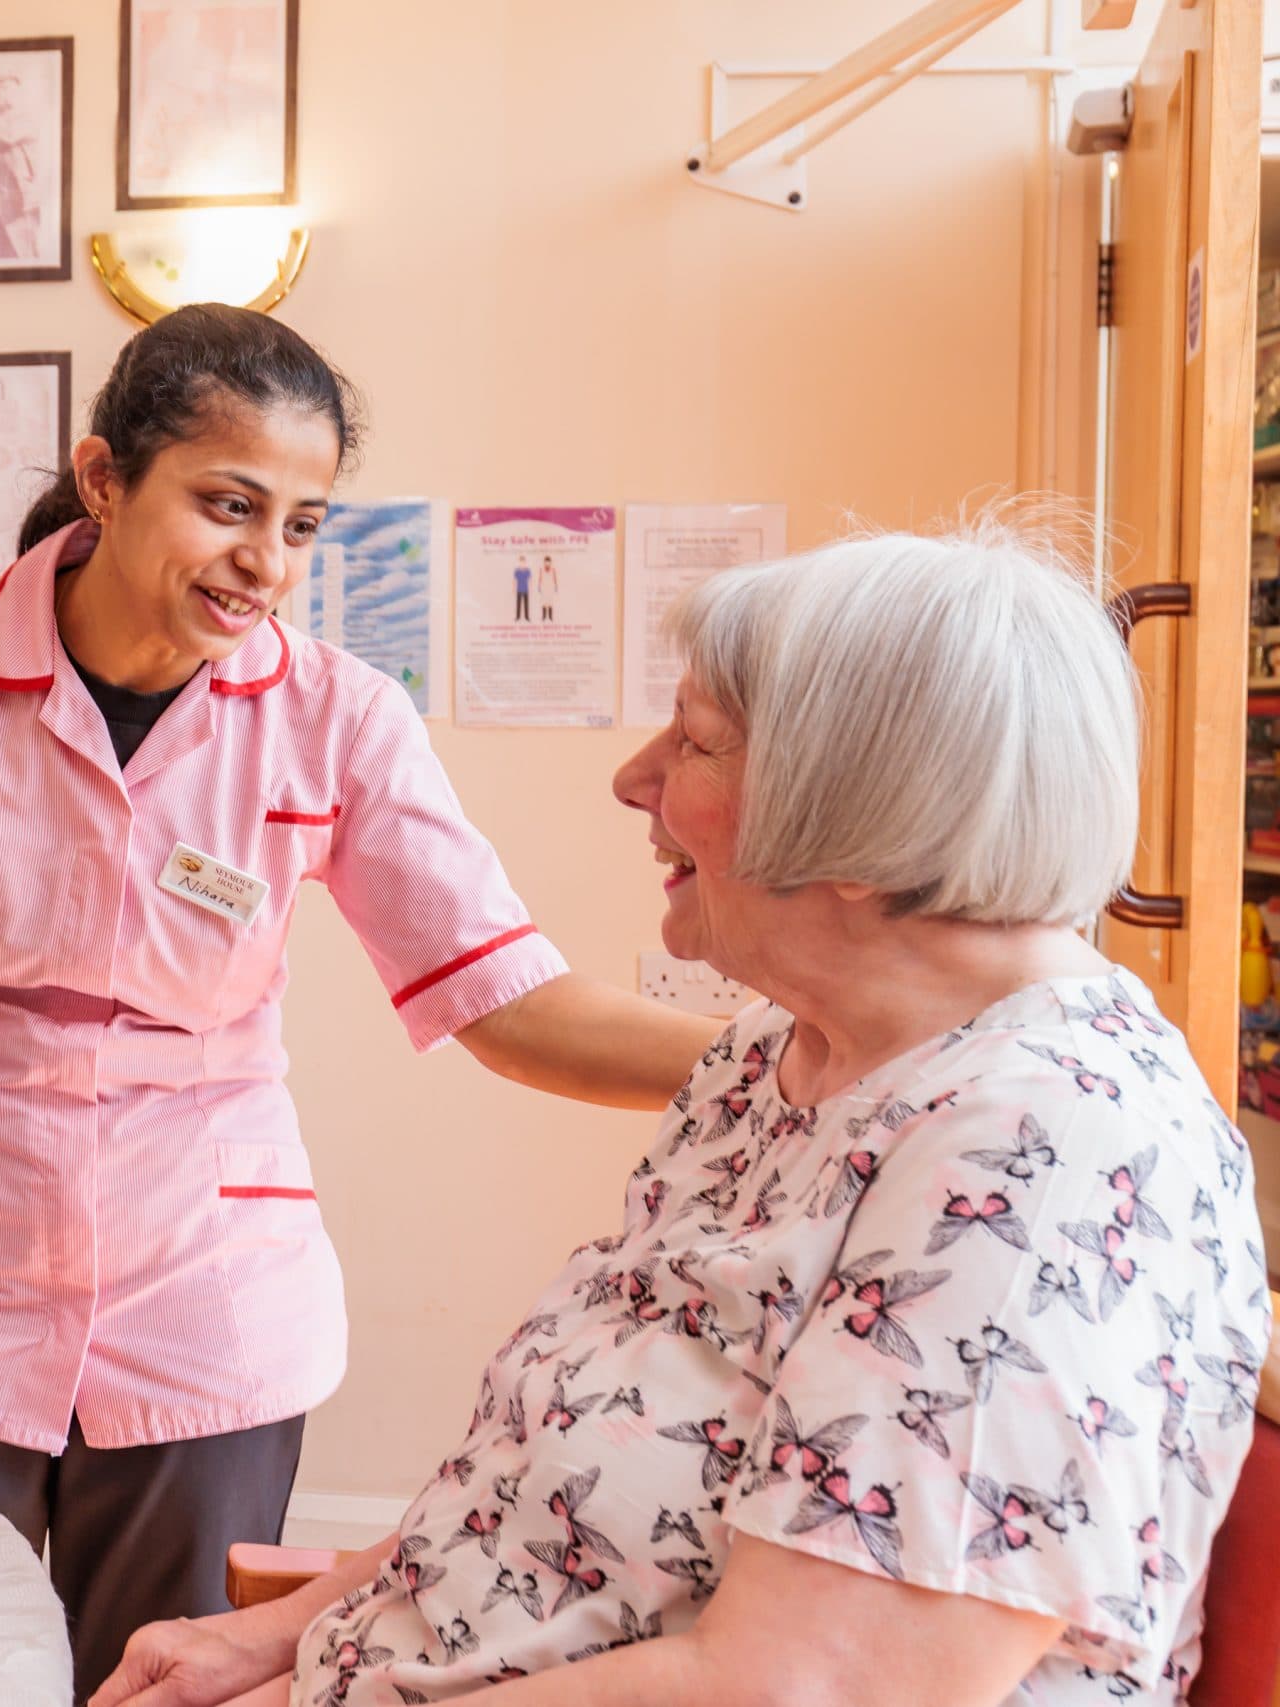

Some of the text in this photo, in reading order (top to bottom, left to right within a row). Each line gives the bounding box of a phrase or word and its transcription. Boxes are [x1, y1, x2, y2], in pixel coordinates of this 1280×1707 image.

[481, 535, 505, 547] Stay
[215, 867, 255, 890] SEYMOUR
[216, 877, 243, 895] HOUSE
[177, 876, 235, 909] Nihara
